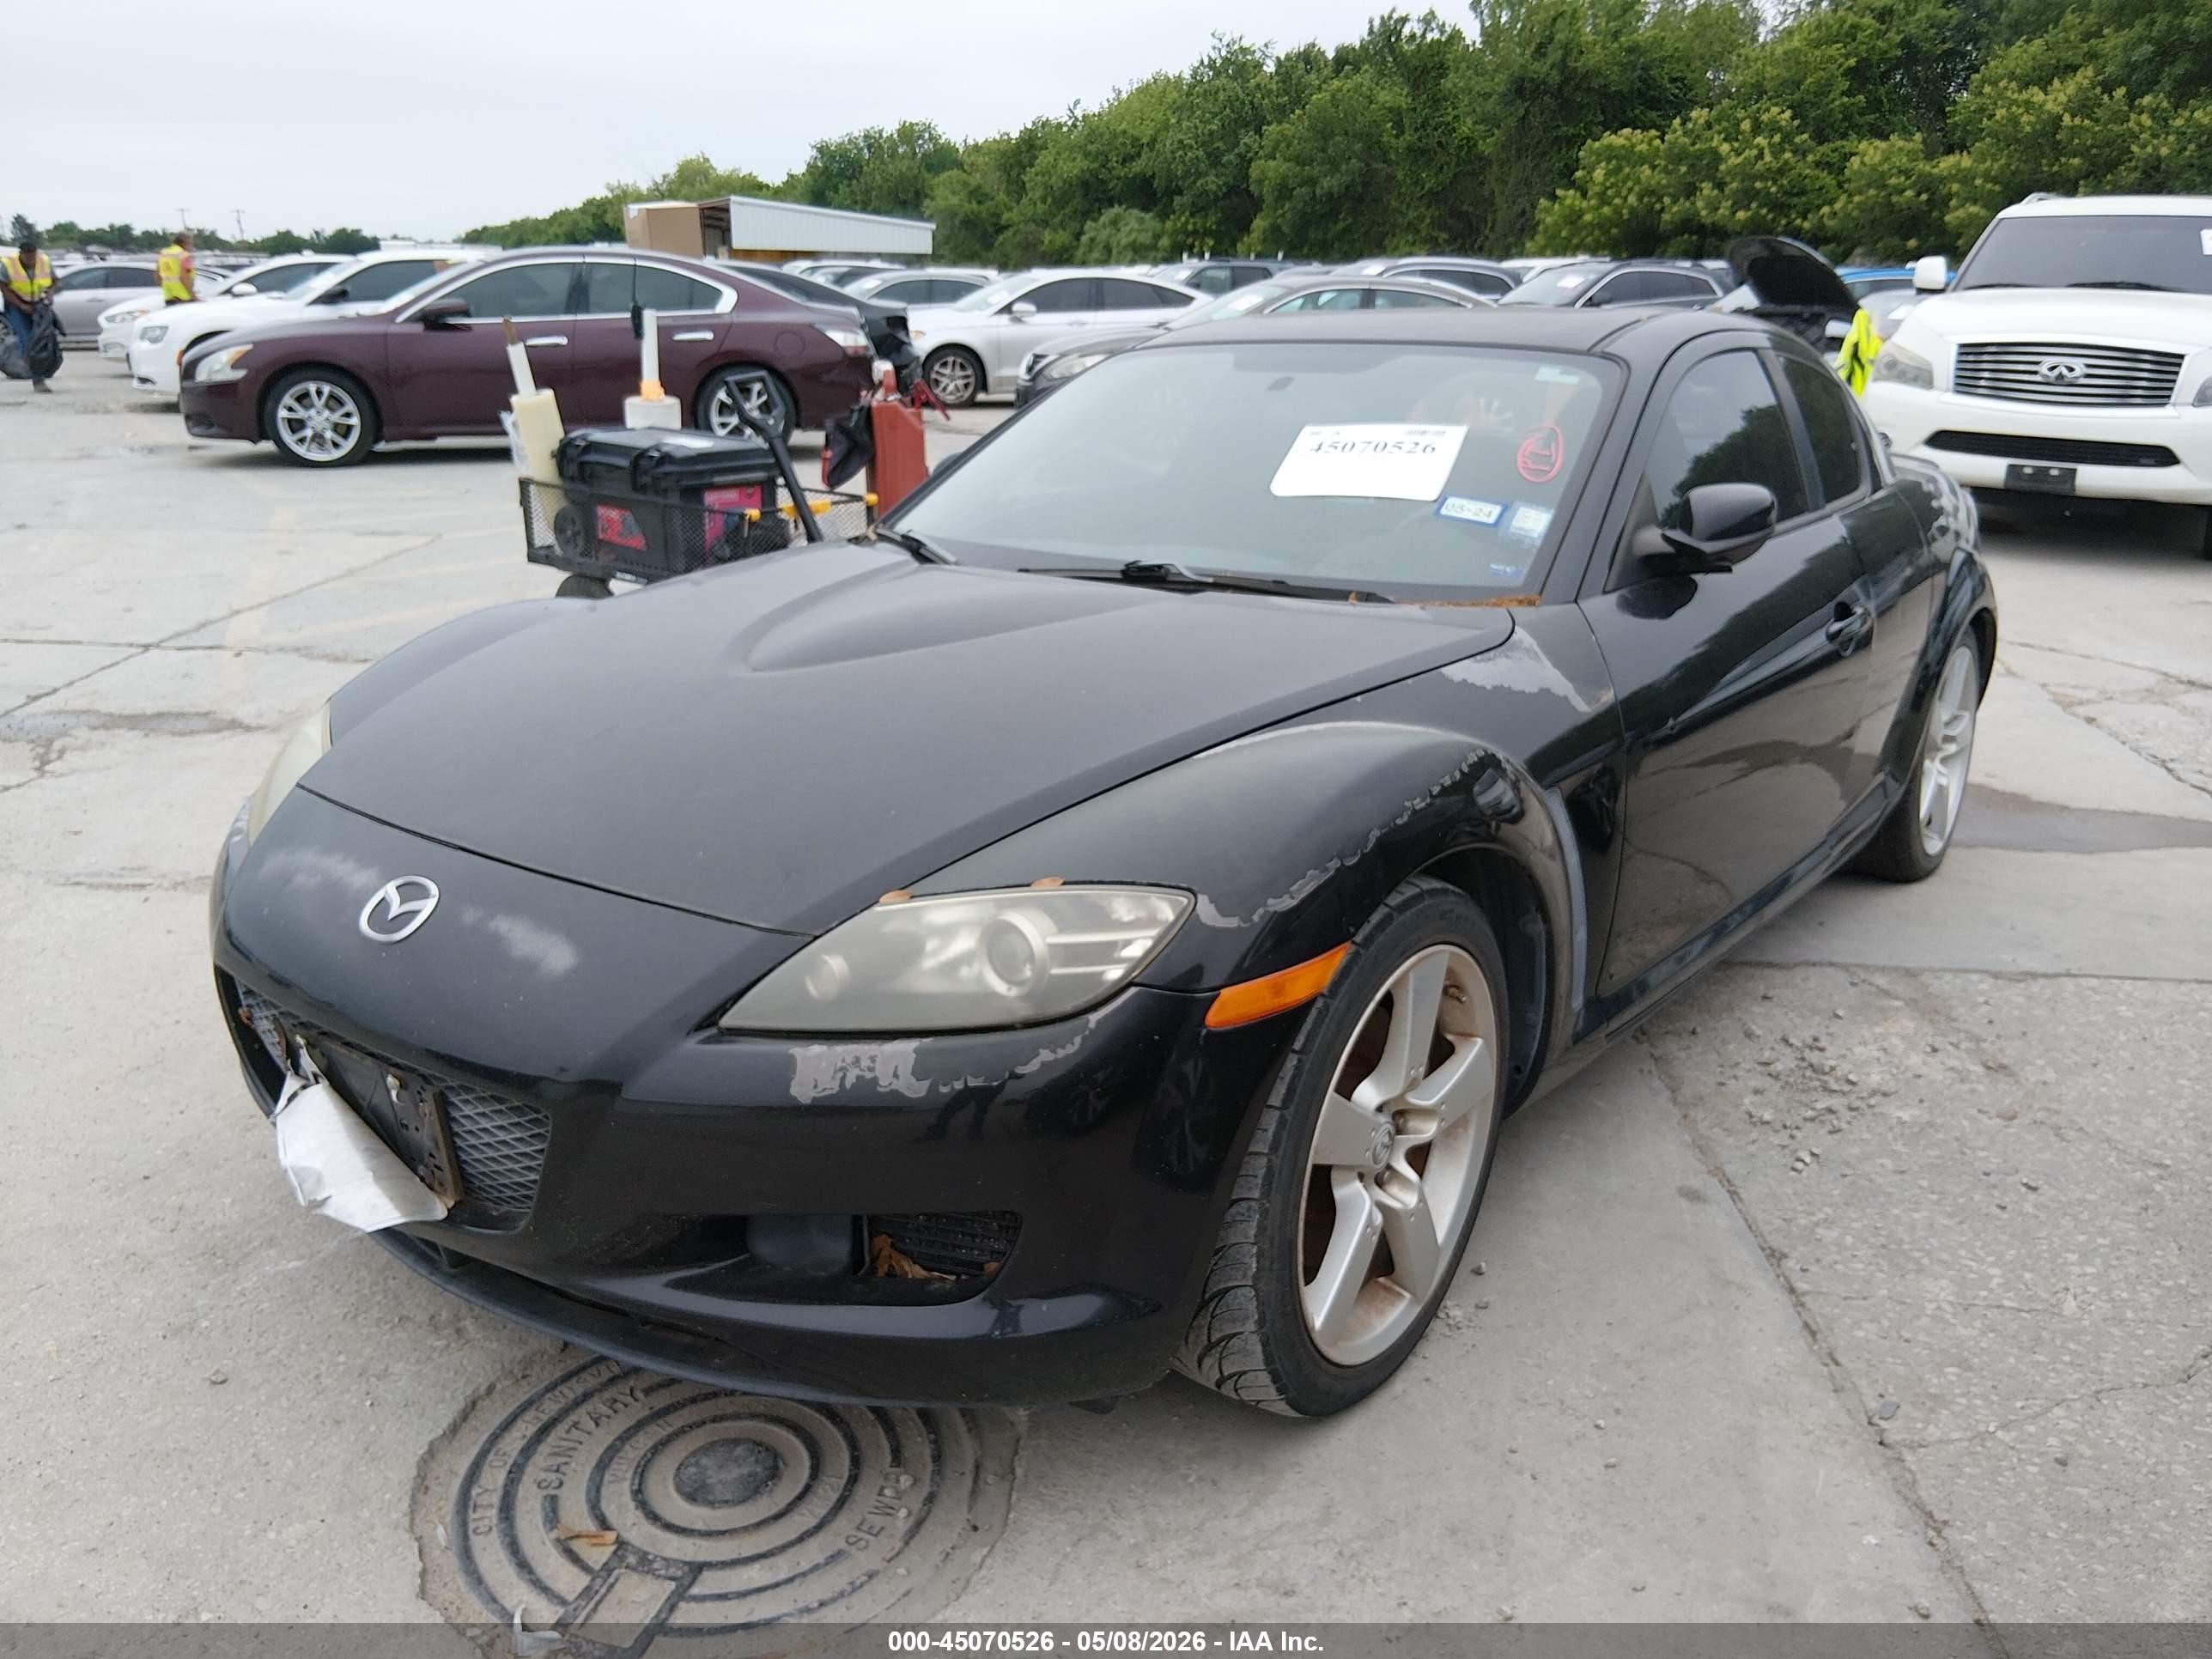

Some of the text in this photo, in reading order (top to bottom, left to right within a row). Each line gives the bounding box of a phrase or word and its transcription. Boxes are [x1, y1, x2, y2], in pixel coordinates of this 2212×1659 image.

[1310, 441, 1437, 454] 45070526
[537, 1383, 641, 1491] SANITARY
[472, 1485, 497, 1536] CITY
[489, 1446, 509, 1469] OF
